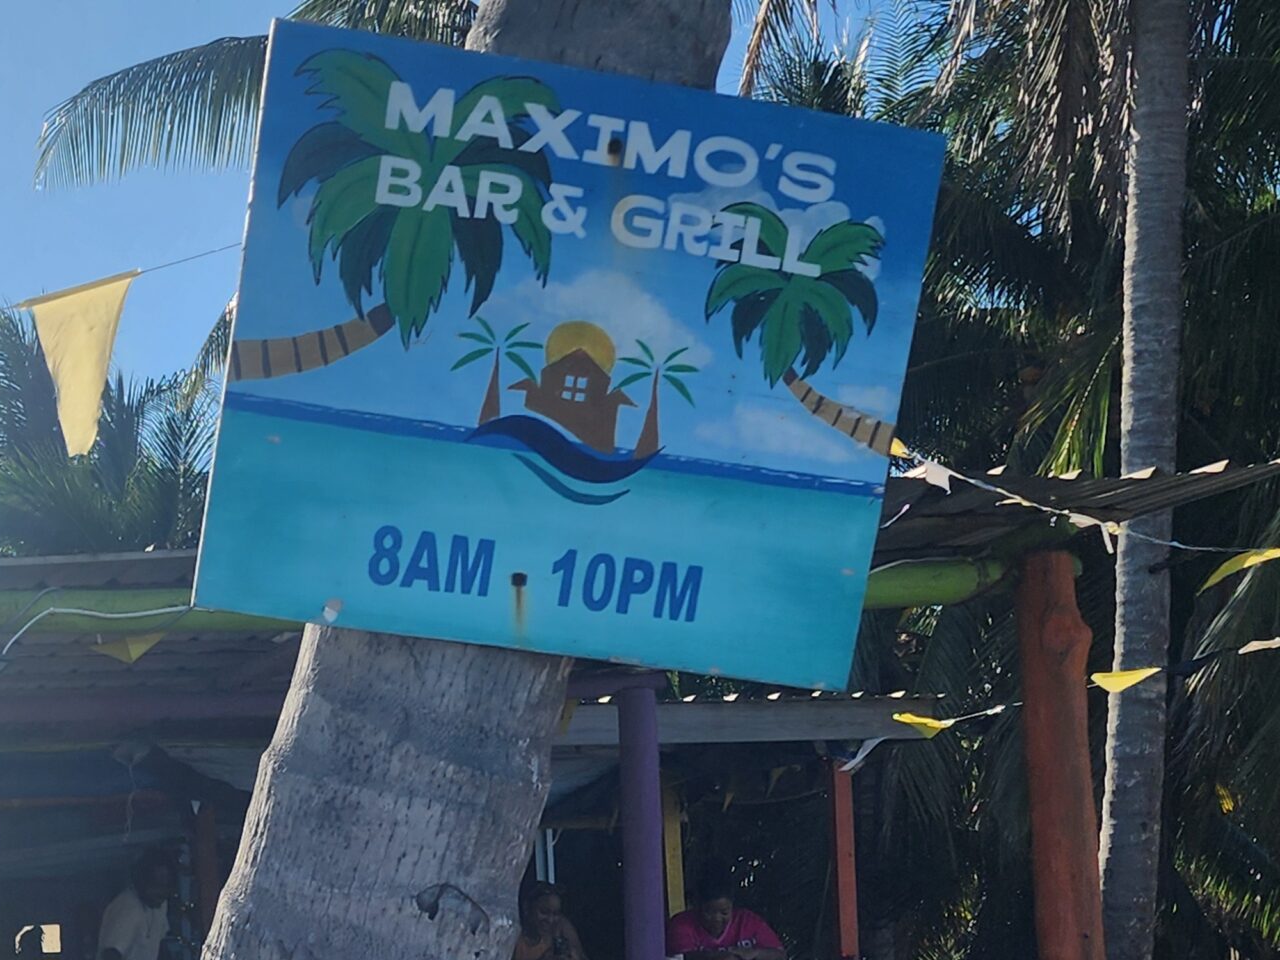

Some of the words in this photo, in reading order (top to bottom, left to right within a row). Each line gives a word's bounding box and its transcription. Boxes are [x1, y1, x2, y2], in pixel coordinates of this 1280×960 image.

[385, 81, 837, 202] MAXIMO'S
[374, 155, 523, 226] BAR
[540, 183, 587, 239] &
[610, 194, 822, 278] GRILL
[368, 525, 496, 598] 8AM
[551, 548, 704, 623] 10PM
